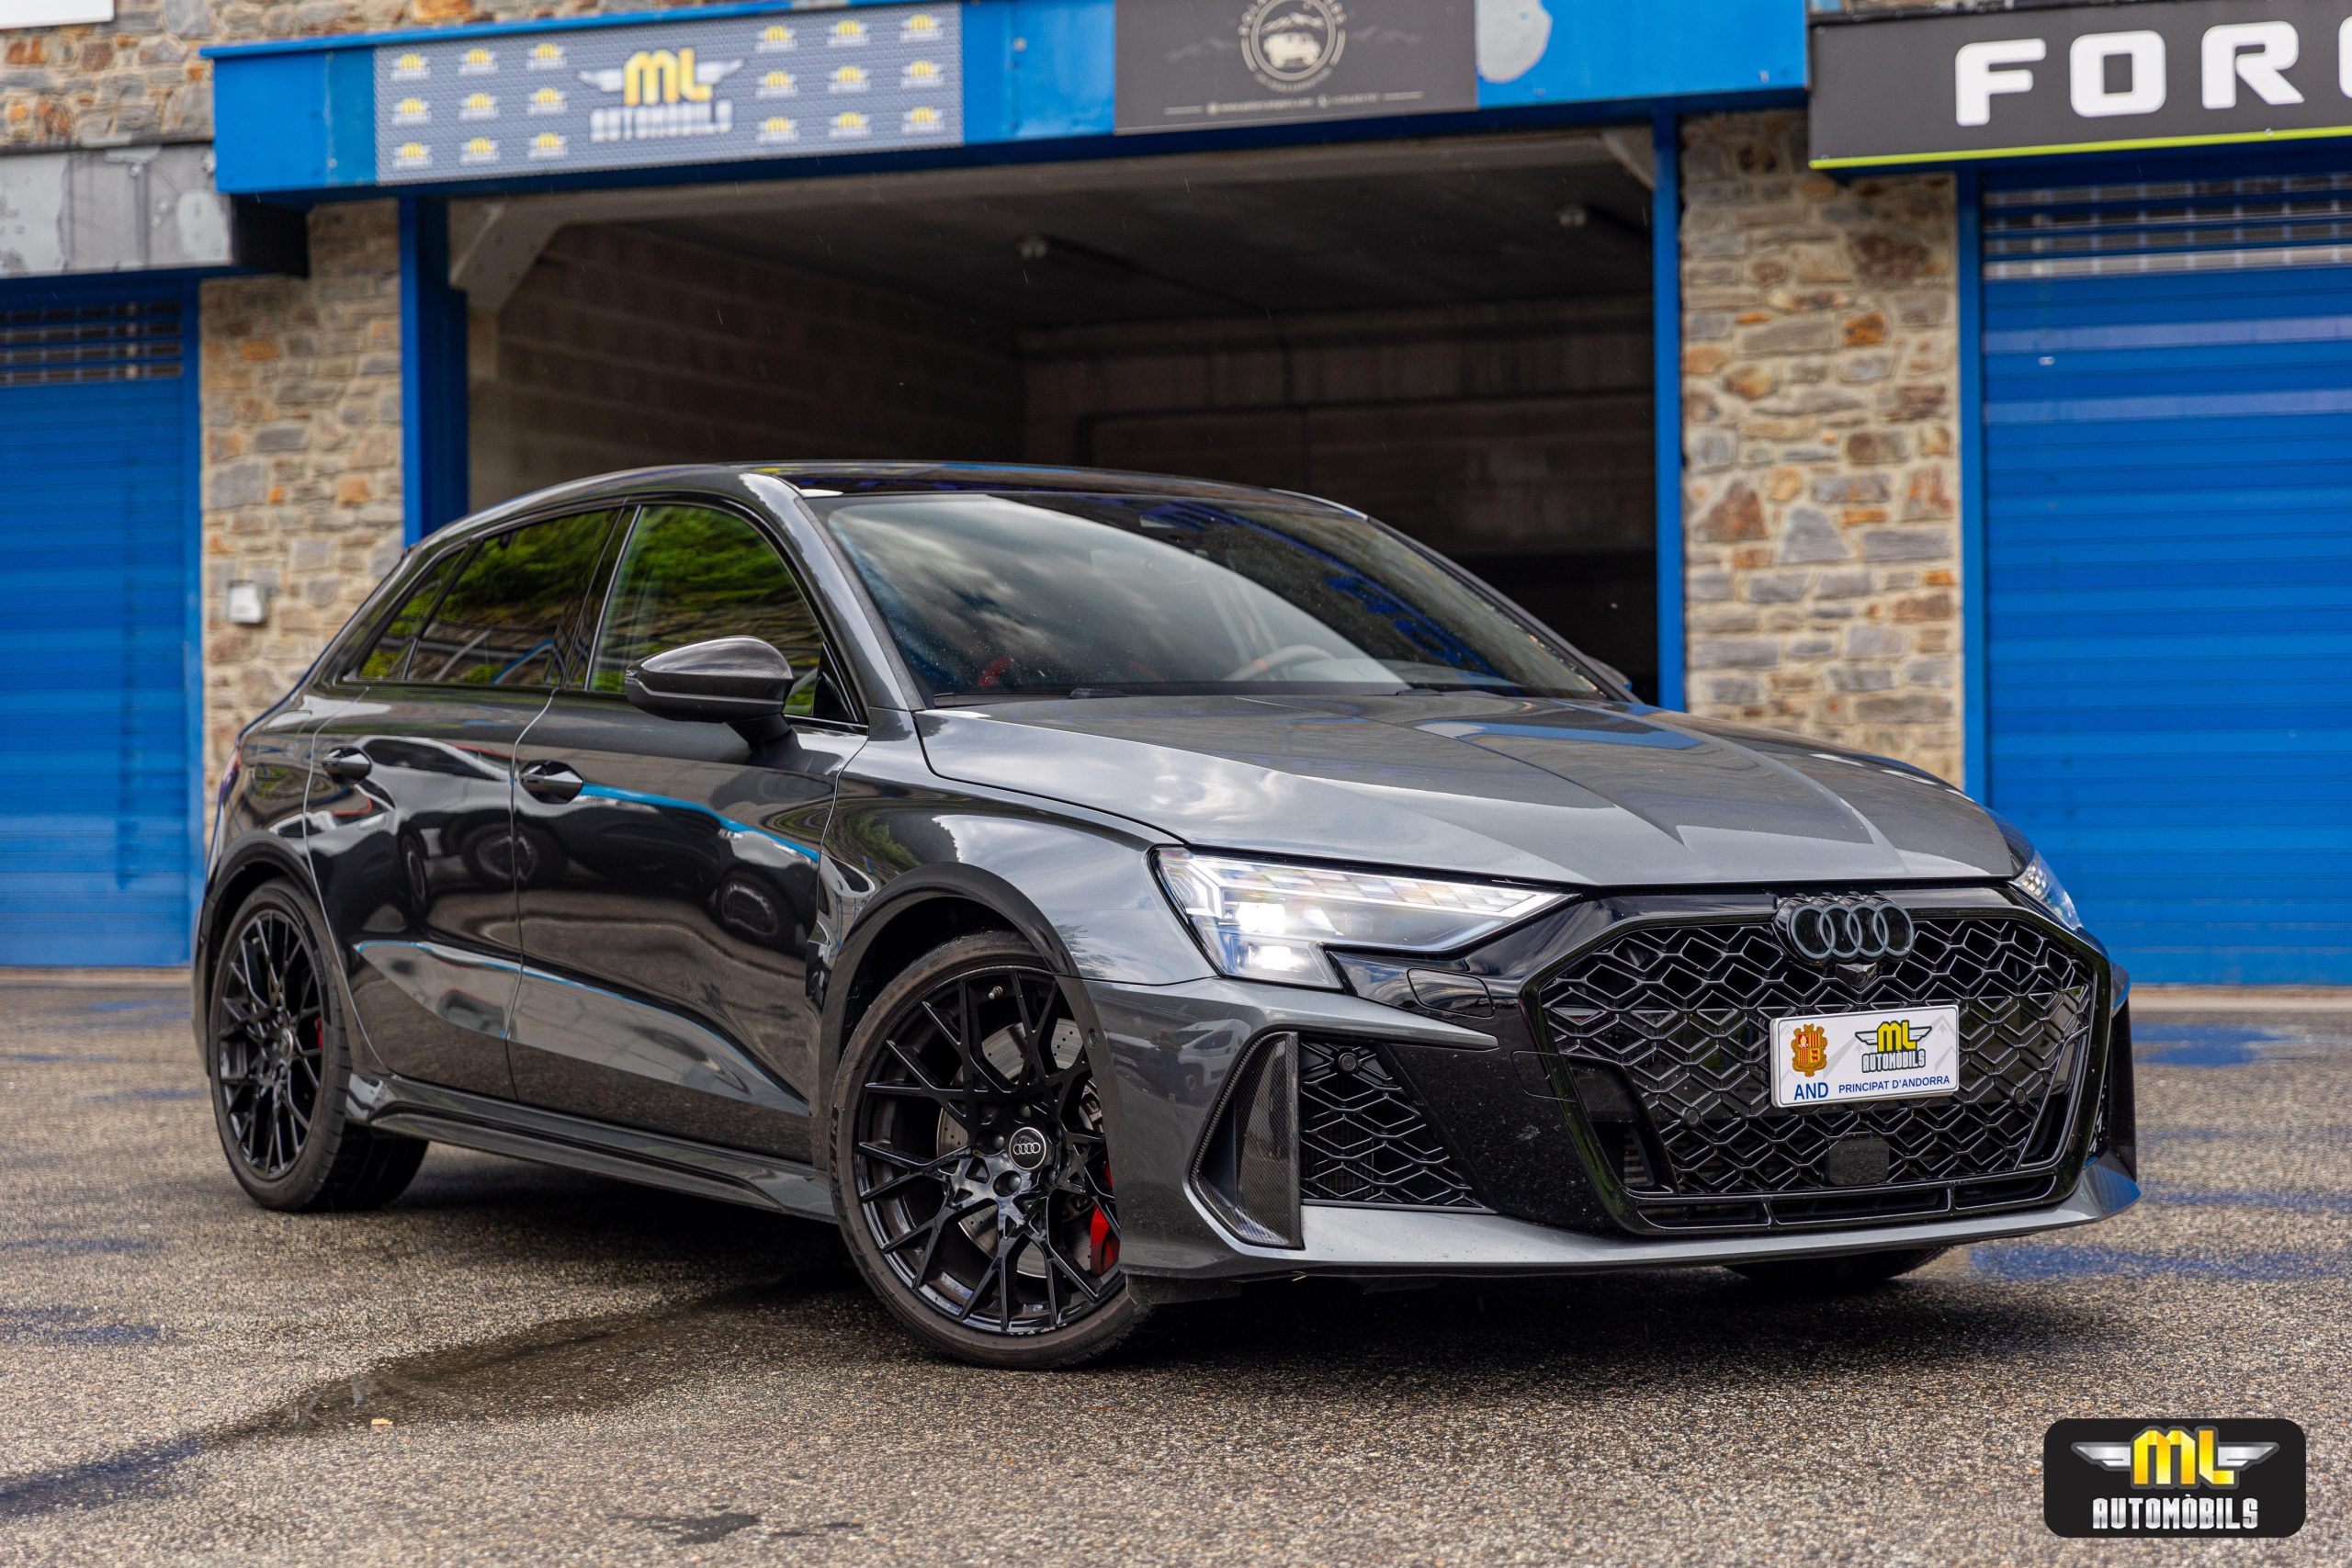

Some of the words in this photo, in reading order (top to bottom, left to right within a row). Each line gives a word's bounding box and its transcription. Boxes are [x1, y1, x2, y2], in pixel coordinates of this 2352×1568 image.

[624, 47, 712, 107] ML
[1955, 16, 2352, 126] FOR
[1877, 1020, 1917, 1053] ML
[1793, 1081, 1829, 1100] AND
[1838, 1080, 1890, 1093] PRINCIPAT
[1892, 1076, 1951, 1089] D'ANDORRA
